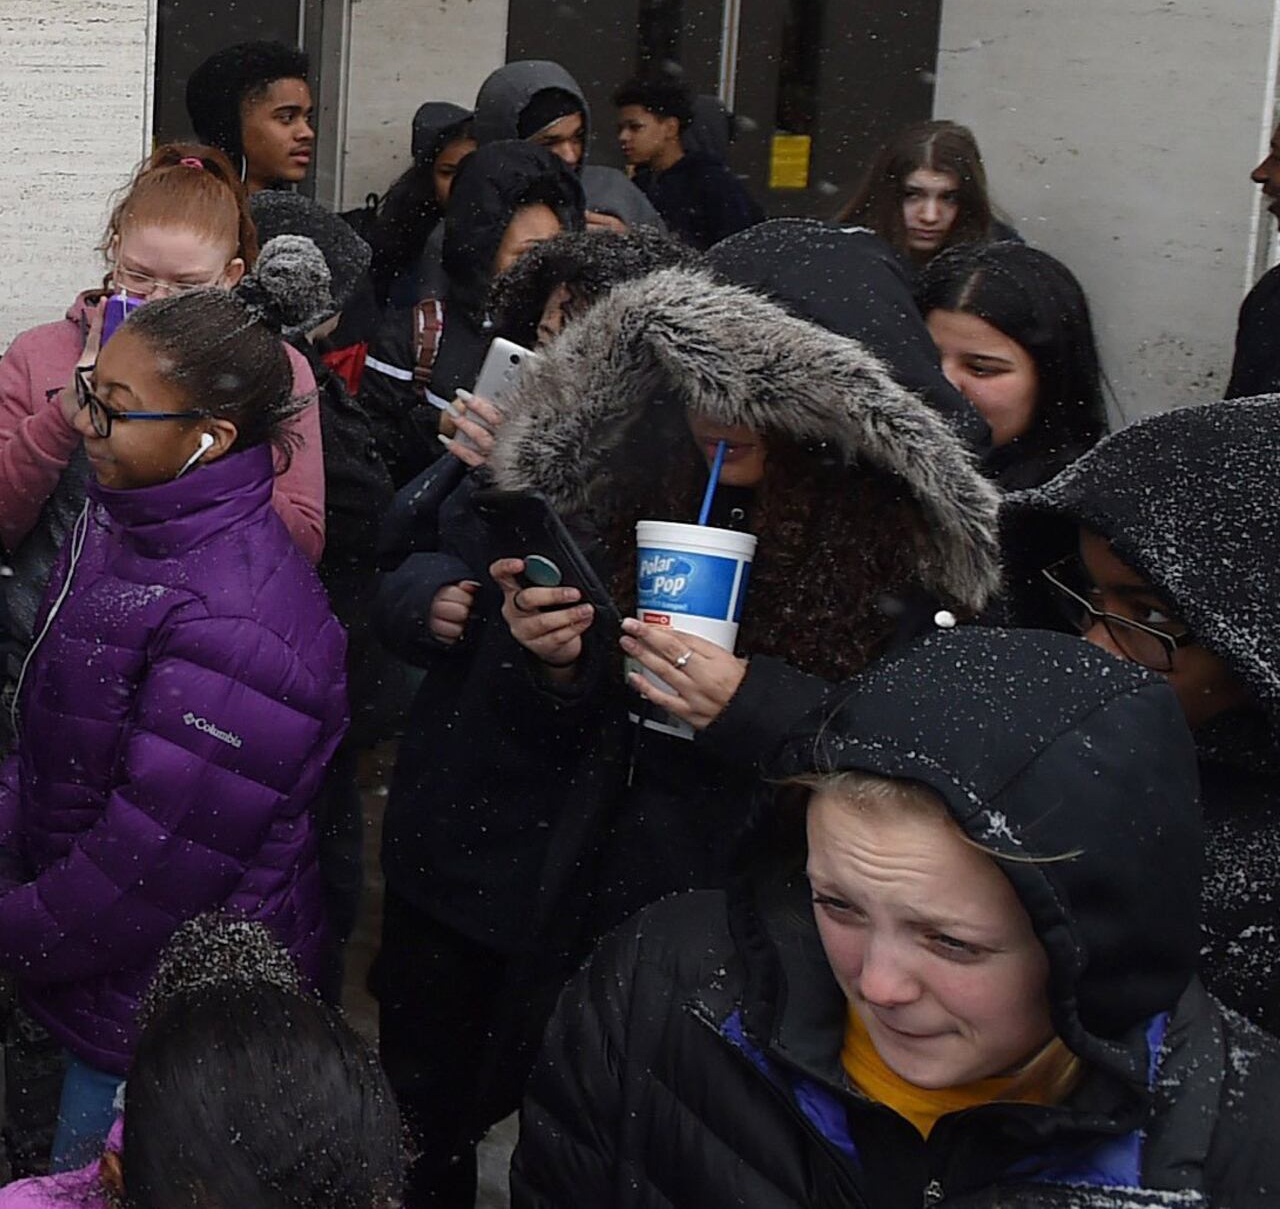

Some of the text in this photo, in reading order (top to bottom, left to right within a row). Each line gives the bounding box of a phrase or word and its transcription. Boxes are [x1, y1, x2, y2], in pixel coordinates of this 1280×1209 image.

[640, 555, 675, 577] Polar
[653, 575, 686, 596] Pop
[195, 717, 242, 748] Columbia
